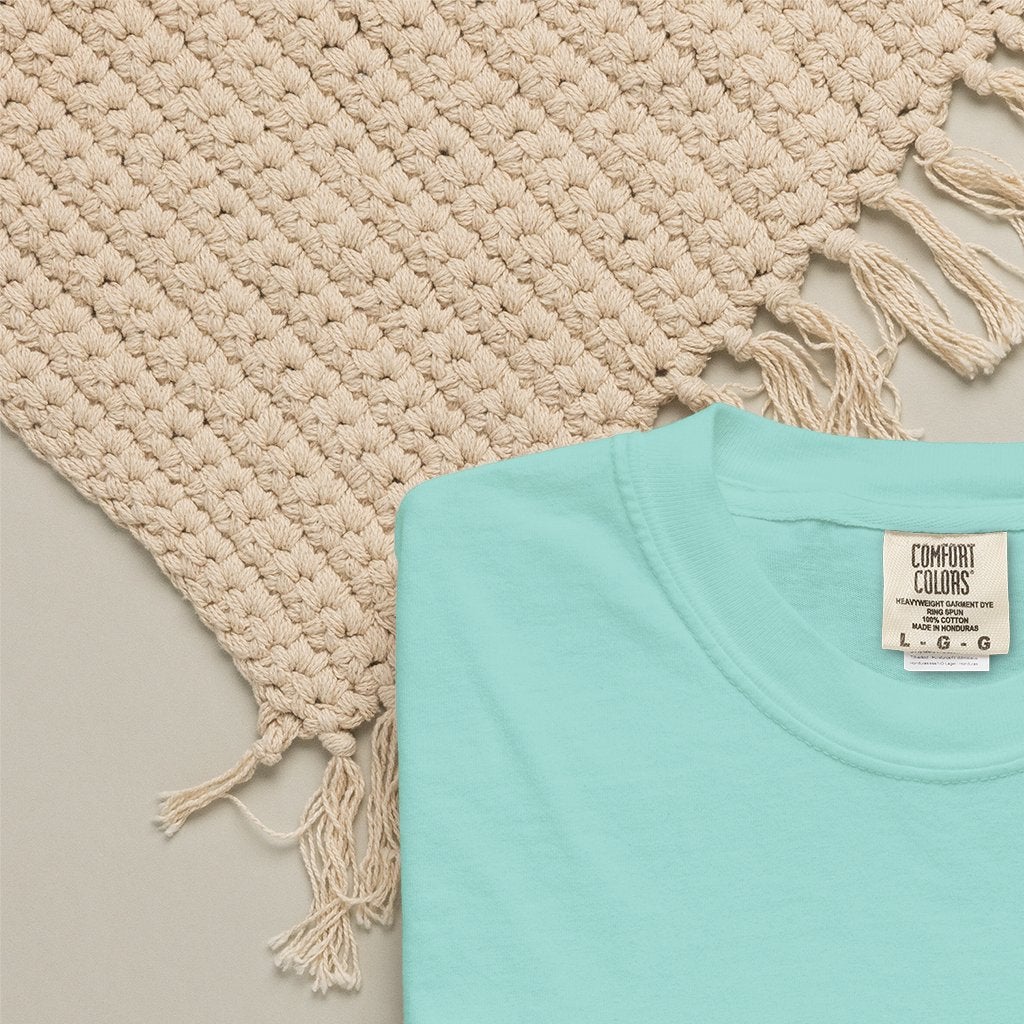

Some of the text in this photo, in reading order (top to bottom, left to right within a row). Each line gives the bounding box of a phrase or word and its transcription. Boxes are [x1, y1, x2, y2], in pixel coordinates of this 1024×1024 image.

[911, 543, 976, 568] COMFORT
[896, 598, 944, 607] HEAVYWEIGHT
[946, 600, 979, 608] GARMENT
[926, 608, 944, 616] RING
[922, 616, 940, 624] 100%
[912, 623, 932, 631] MADE
[900, 633, 911, 647] L
[936, 636, 950, 650] G
[978, 636, 991, 650] G
